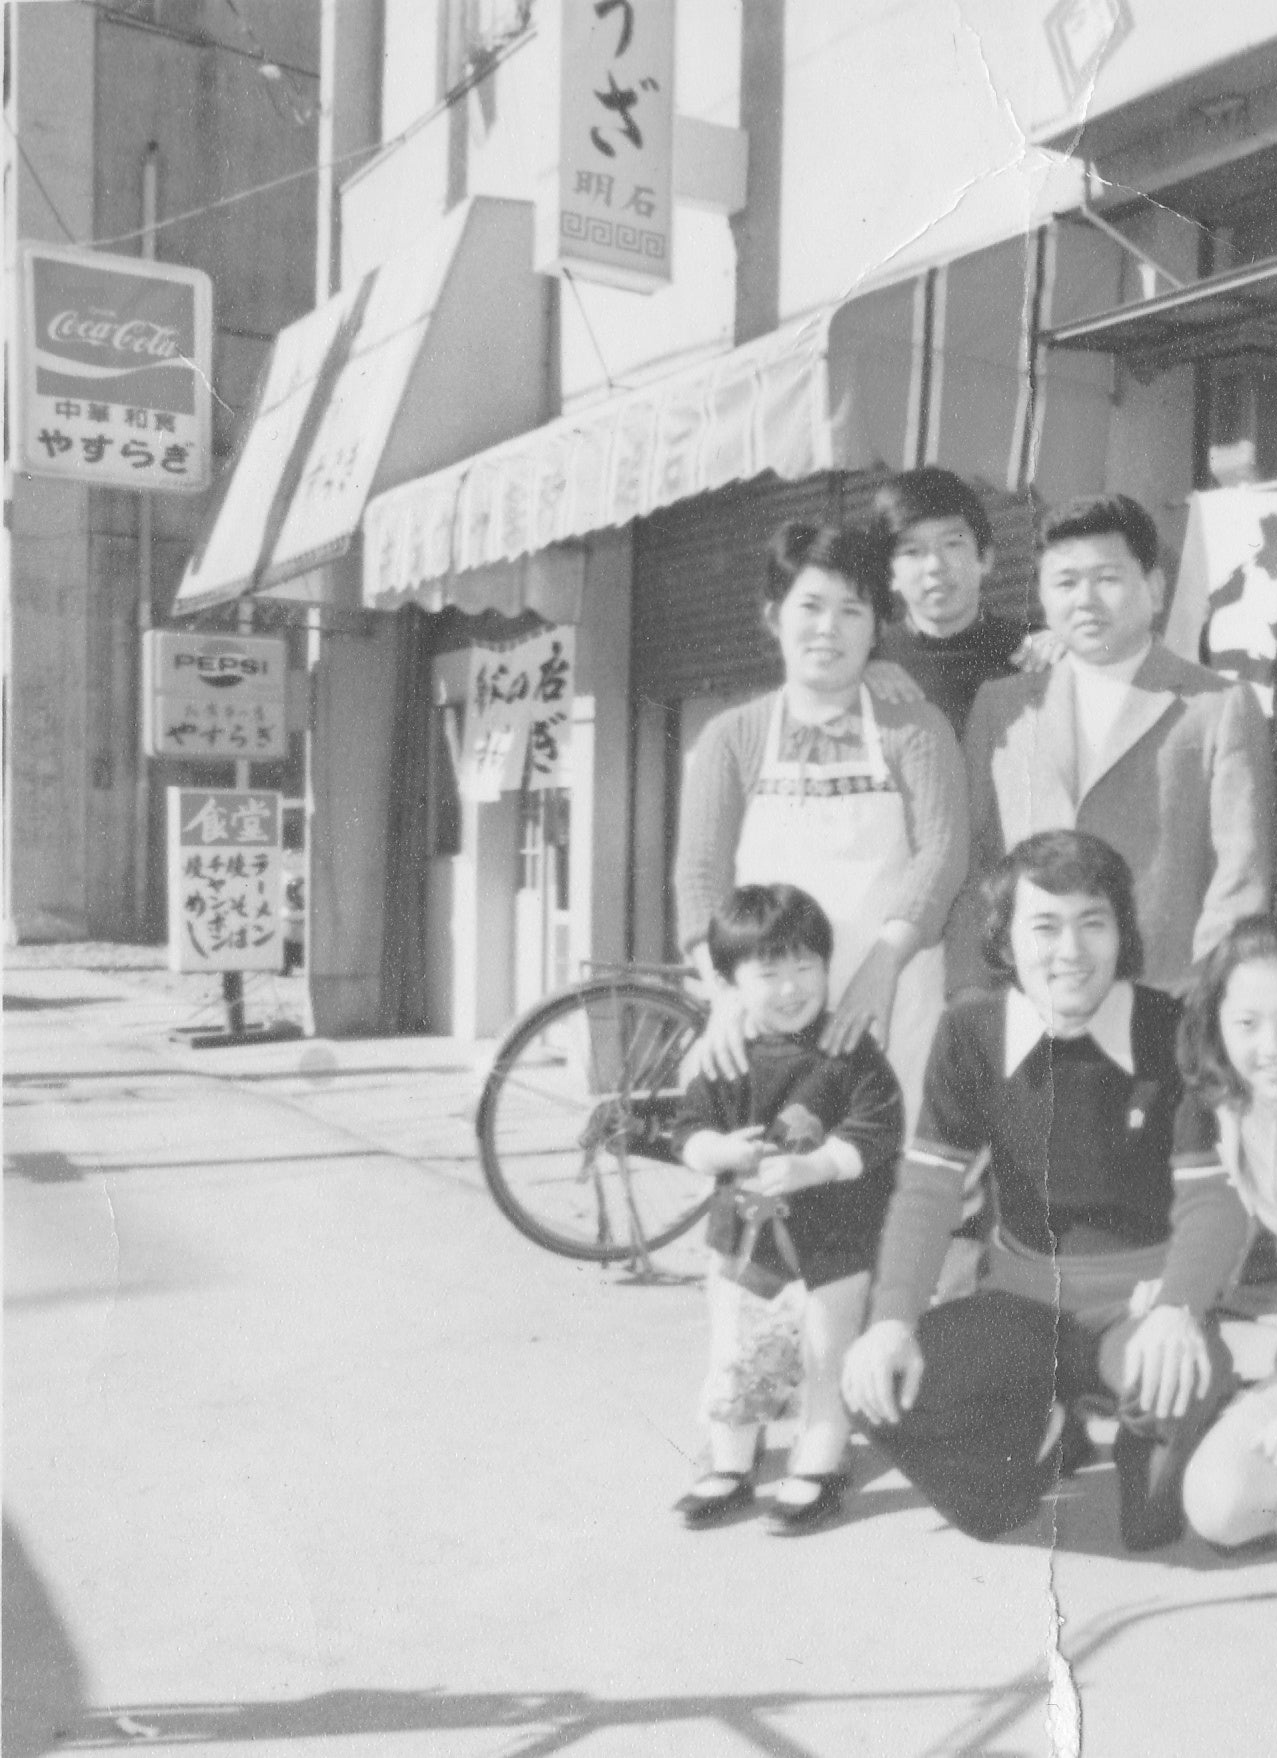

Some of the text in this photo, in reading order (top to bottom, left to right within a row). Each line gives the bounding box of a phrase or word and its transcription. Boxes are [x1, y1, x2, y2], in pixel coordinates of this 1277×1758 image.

[574, 169, 657, 219] 明石
[37, 428, 195, 475] やすらぎ
[174, 653, 268, 675] PEPSI
[182, 797, 271, 844] 食堂
[252, 852, 275, 946] ラーメン
